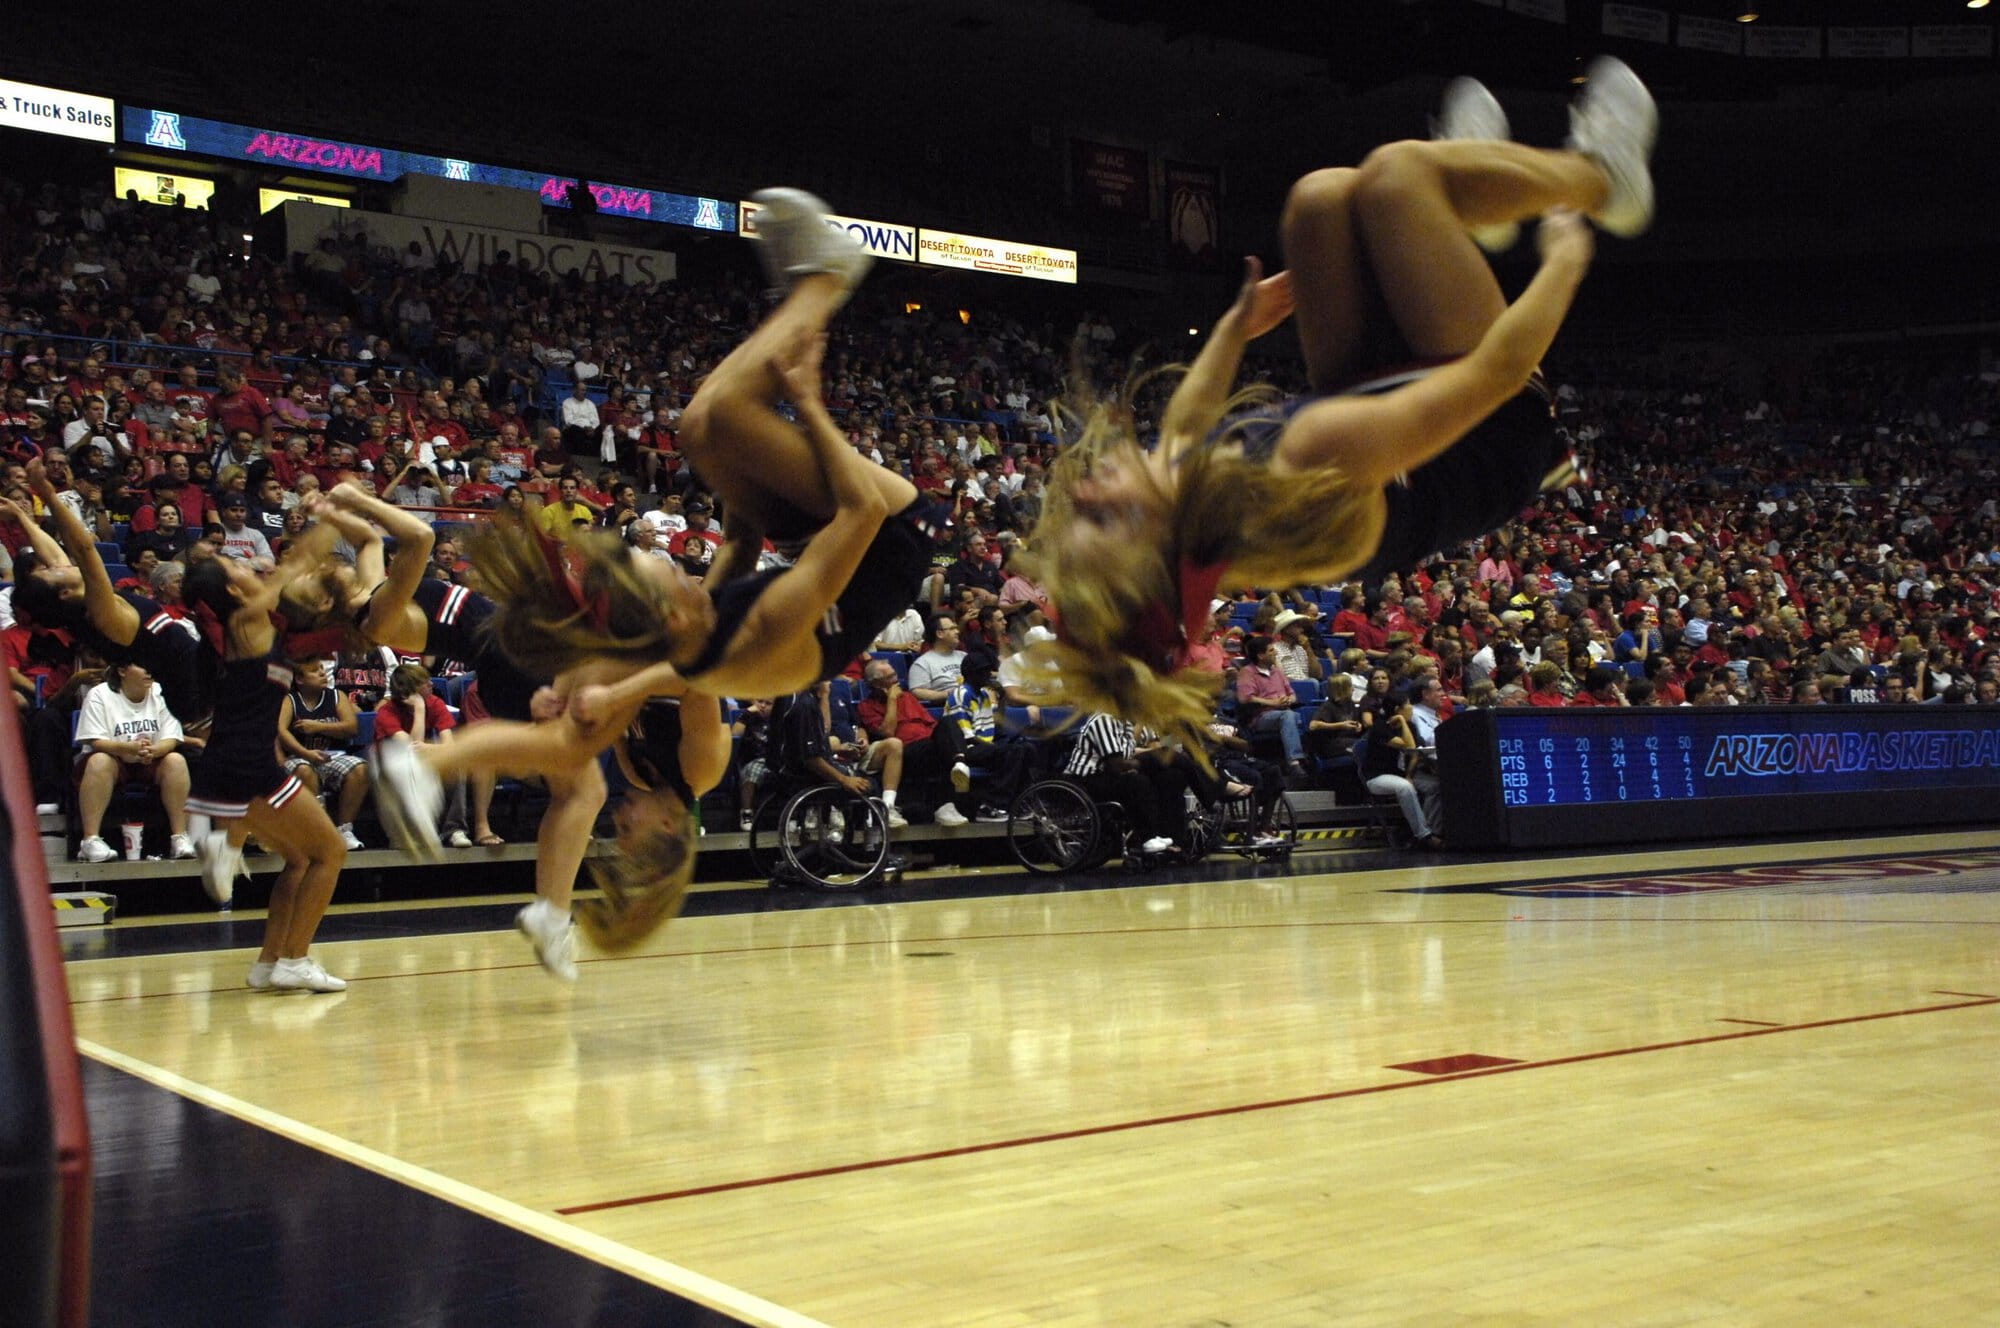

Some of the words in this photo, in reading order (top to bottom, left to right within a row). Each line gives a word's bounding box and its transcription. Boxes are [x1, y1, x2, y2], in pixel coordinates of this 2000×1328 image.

[13, 97, 62, 119] Truck
[67, 106, 113, 128] Sales
[246, 132, 383, 175] ARIZONA
[540, 177, 652, 214] ARONA
[423, 226, 657, 289] WILDCATS
[921, 239, 955, 253] DESERT
[958, 245, 994, 259] TOYOTA
[1005, 251, 1038, 265] DESERT
[1041, 256, 1075, 270] TOYOTA
[1850, 688, 1880, 703] POSS.
[1499, 739, 1524, 753] PLR
[1539, 738, 1554, 753] 05
[1576, 737, 1590, 751] 20
[1610, 737, 1624, 751] 34
[1645, 736, 1659, 750] 42
[1679, 736, 1691, 749] 50
[1500, 756, 1526, 770] PTS
[1544, 755, 1552, 769] 6
[1580, 754, 1588, 768] 2
[1612, 754, 1626, 768] 24
[1650, 753, 1657, 766] 6
[1683, 752, 1690, 765] 4
[1502, 773, 1528, 787] REB
[1547, 771, 1553, 785] 1
[1582, 771, 1589, 784] 2
[1618, 770, 1624, 783] 1
[1651, 769, 1659, 781] 4
[1685, 768, 1693, 780] 2
[1504, 790, 1528, 804] FLS
[1548, 789, 1555, 803] 2
[1584, 787, 1592, 801] 3
[1619, 786, 1627, 800] 0
[1653, 785, 1661, 798] 3
[1687, 784, 1694, 797] 3
